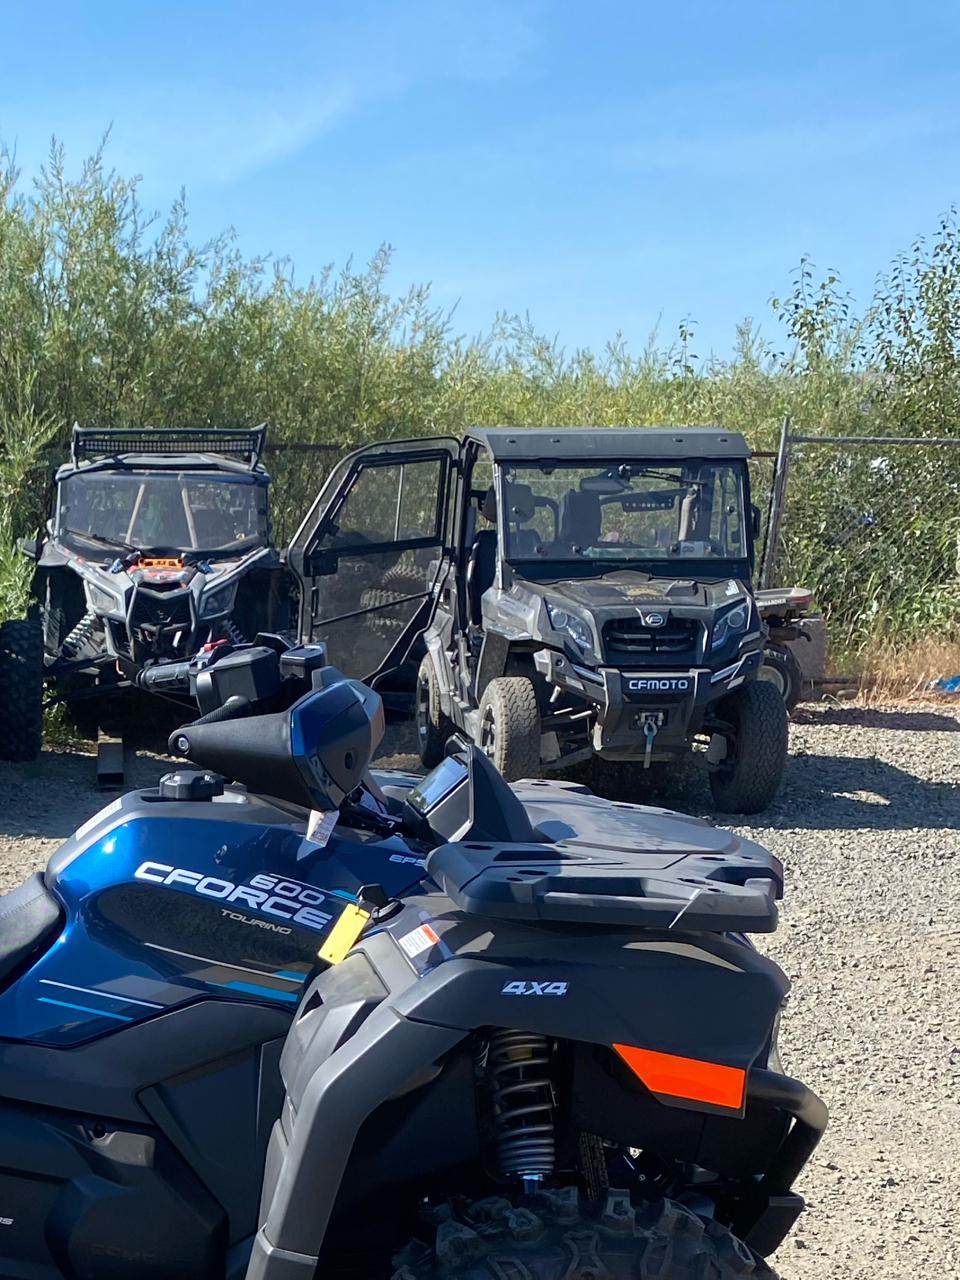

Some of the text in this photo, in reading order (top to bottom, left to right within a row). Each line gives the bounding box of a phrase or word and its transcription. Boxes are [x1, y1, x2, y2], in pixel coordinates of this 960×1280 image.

[628, 679, 689, 691] CFMOTO
[388, 854, 427, 868] EPS
[134, 861, 333, 930] CFORCE
[249, 873, 326, 906] 600
[221, 908, 293, 935] TOURING
